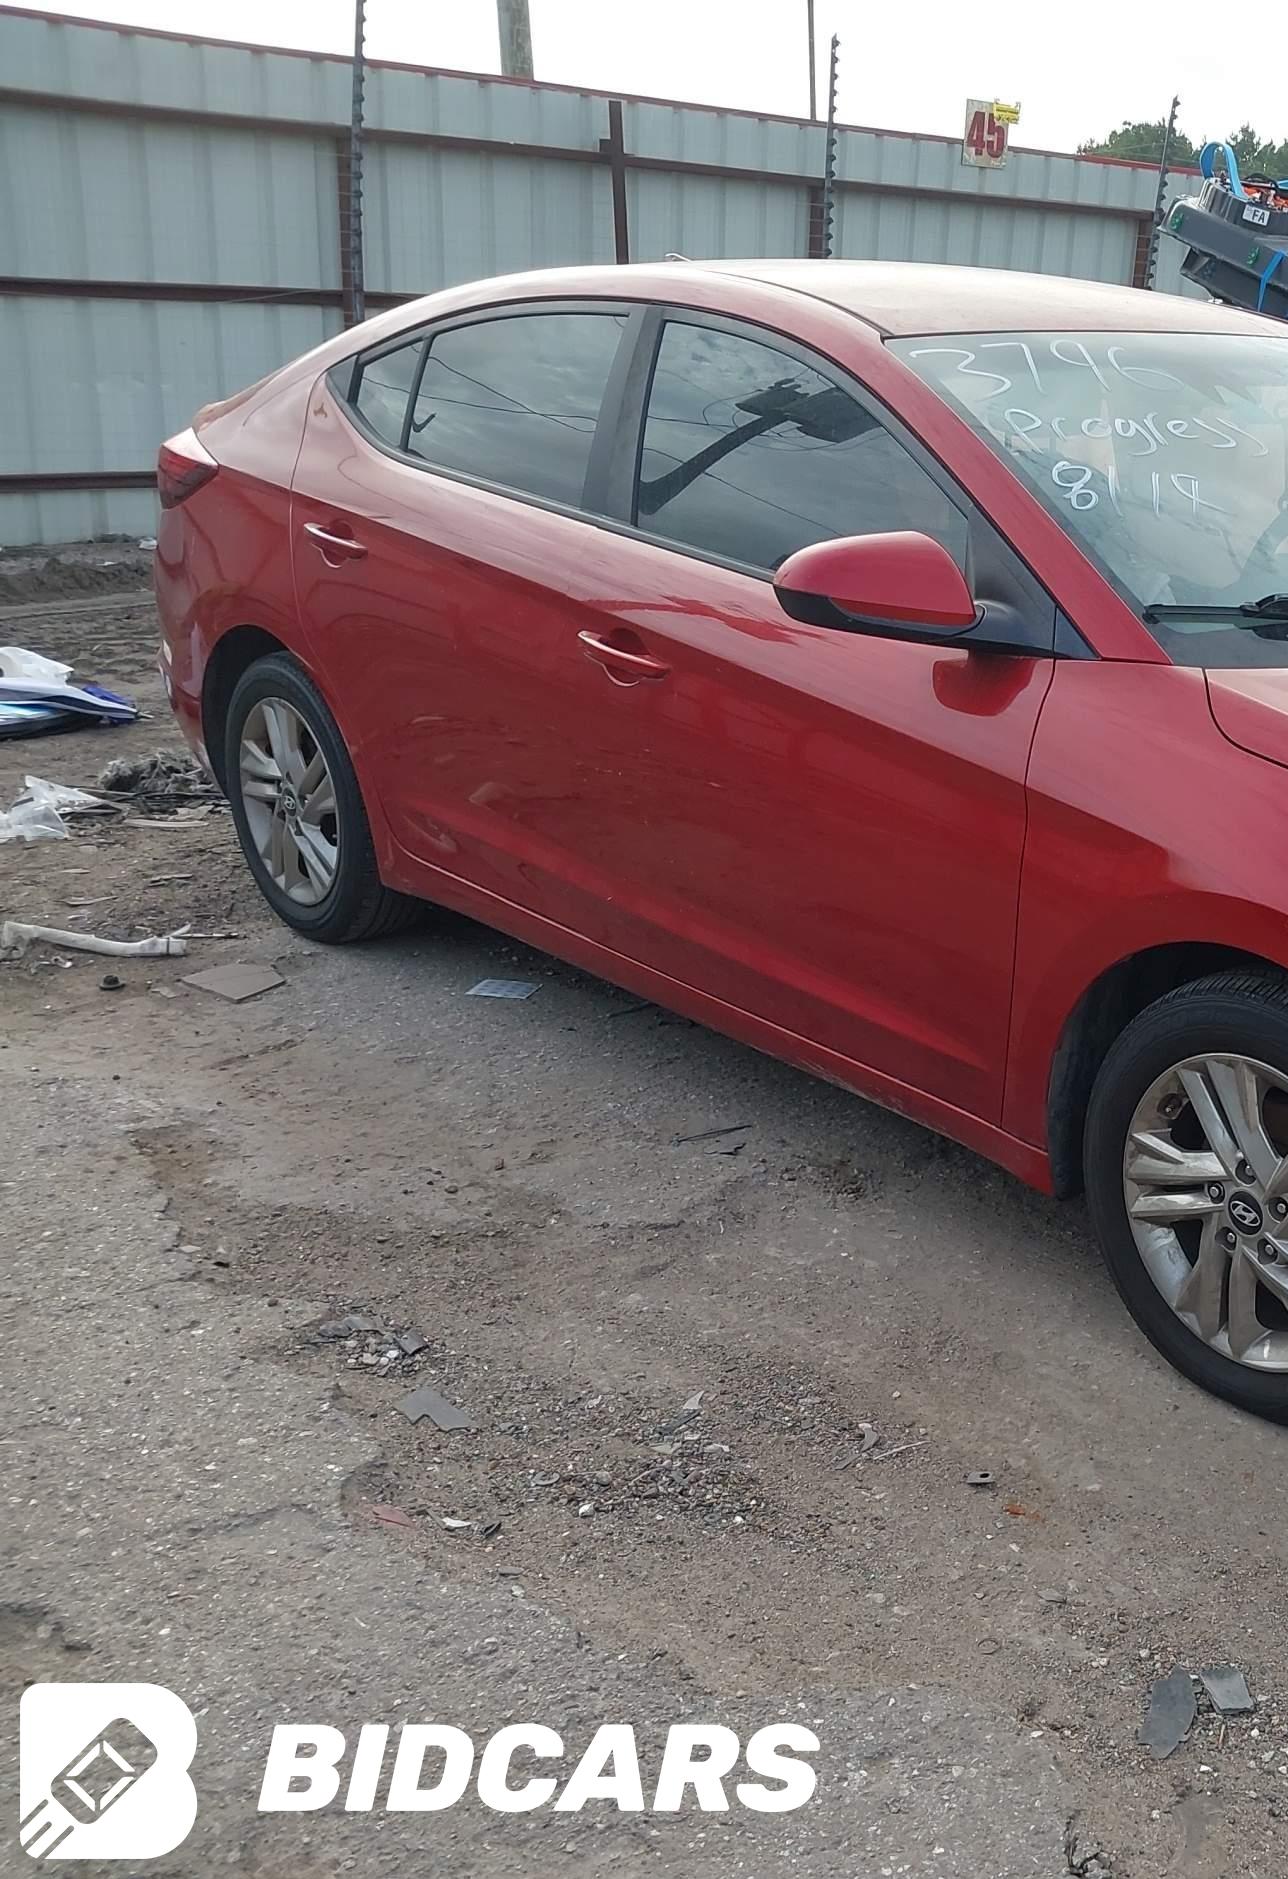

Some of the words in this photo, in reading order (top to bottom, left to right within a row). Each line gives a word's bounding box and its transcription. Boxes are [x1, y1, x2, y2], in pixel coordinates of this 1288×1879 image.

[966, 111, 1005, 158] 45
[1251, 209, 1266, 224] FA
[909, 340, 1187, 398] 3796
